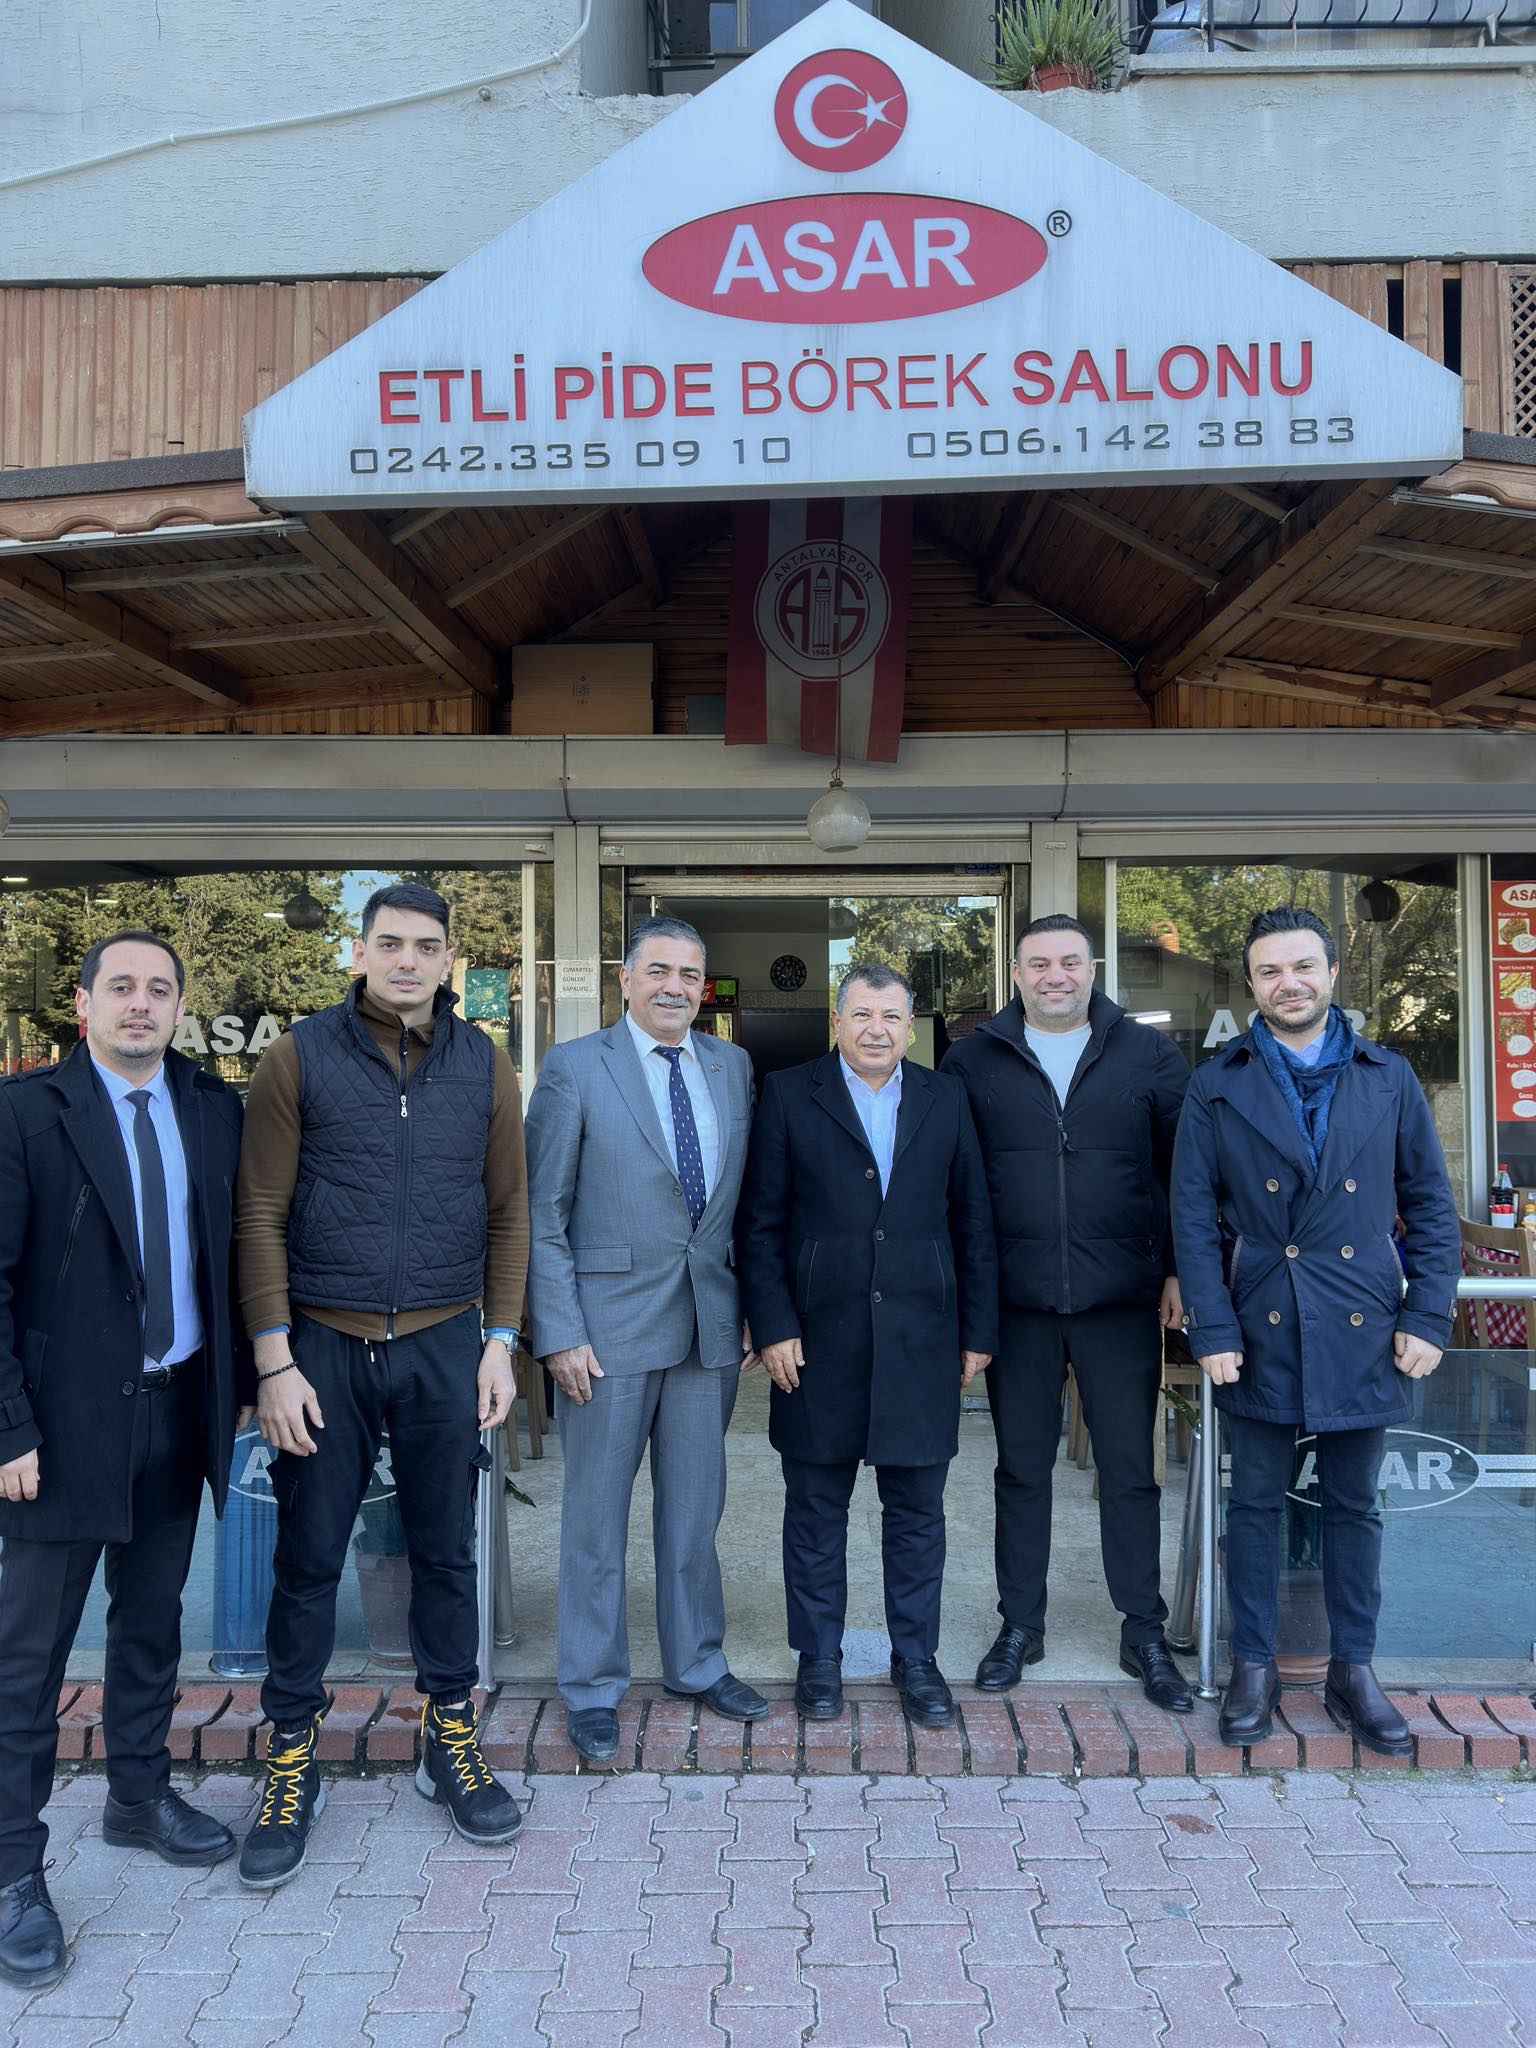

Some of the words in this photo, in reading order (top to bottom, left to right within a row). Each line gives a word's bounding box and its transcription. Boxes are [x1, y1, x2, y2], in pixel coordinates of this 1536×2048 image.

[713, 217, 976, 295] ASAR
[379, 353, 526, 424] ETLİ
[554, 351, 715, 420] PİDE
[742, 349, 989, 414] BÖREK
[1012, 340, 1313, 405] SALONU
[350, 443, 611, 474] 0242.335
[636, 440, 700, 467] 09
[733, 437, 791, 465] 10
[907, 424, 1170, 458] 0506.142
[1198, 420, 1263, 448] 38
[1290, 417, 1354, 445] 83
[774, 547, 874, 584] ANTALYASPOR
[172, 1015, 309, 1054] ASA
[1295, 1451, 1456, 1490] AAR
